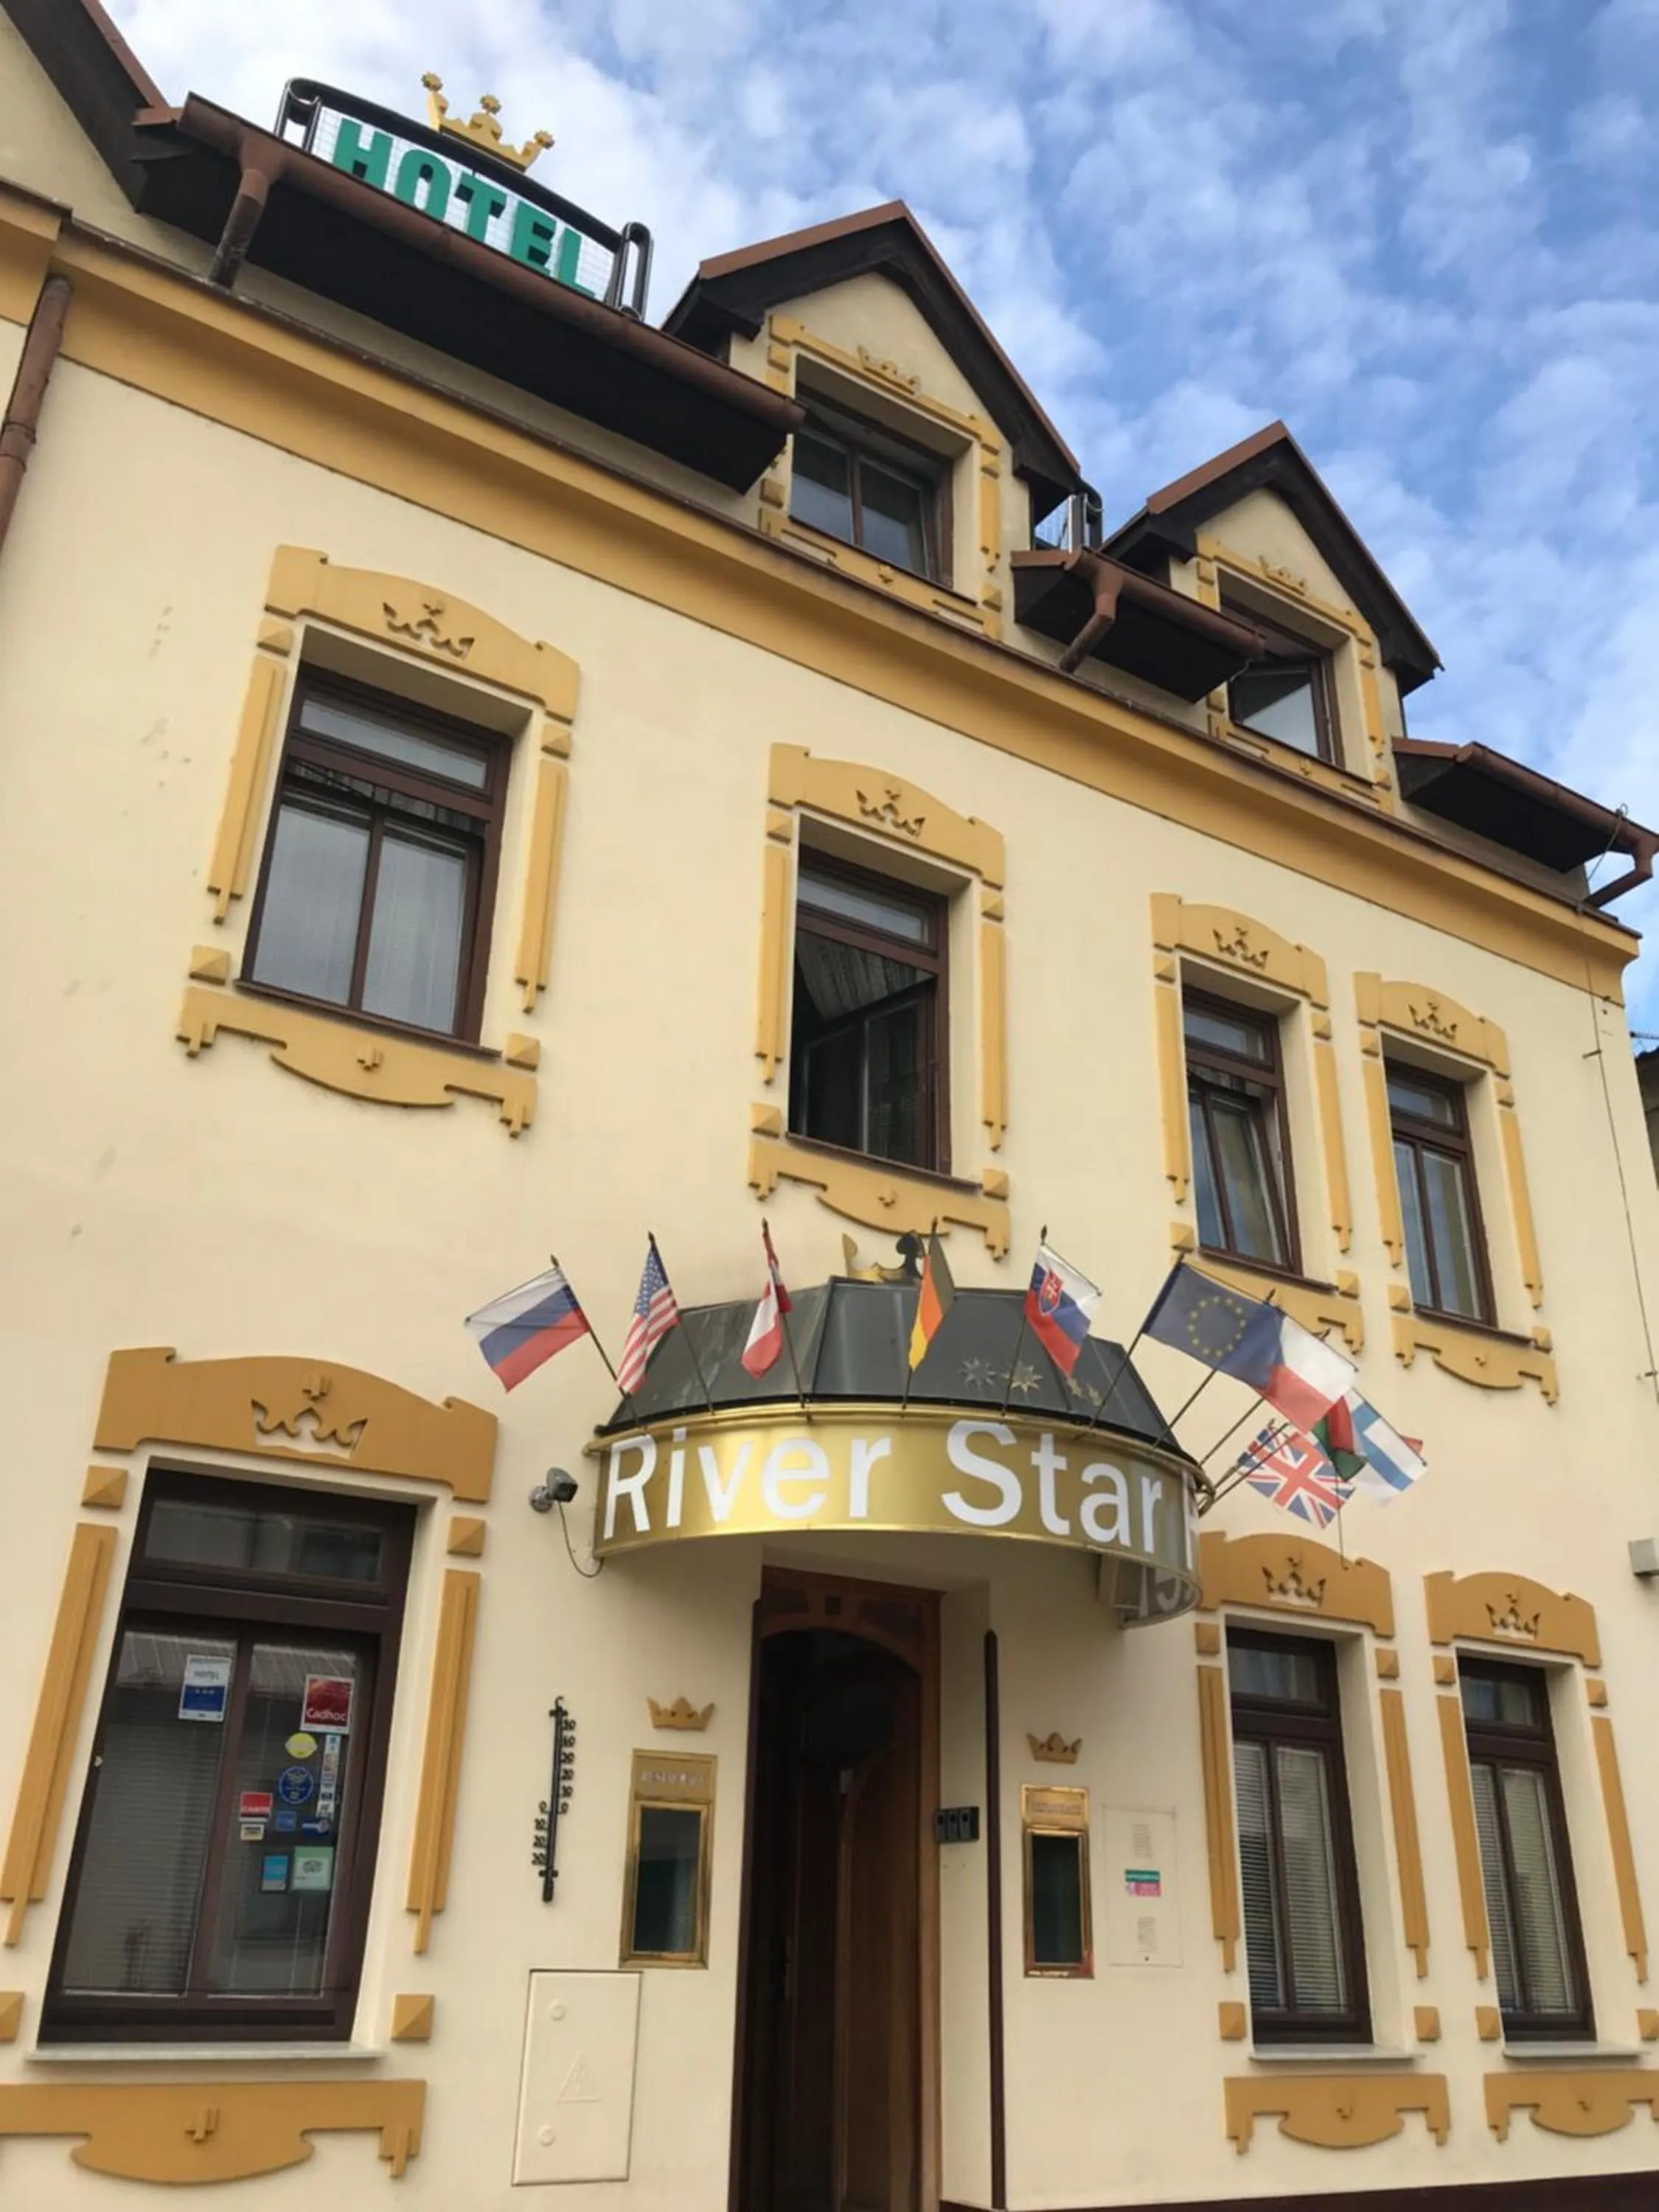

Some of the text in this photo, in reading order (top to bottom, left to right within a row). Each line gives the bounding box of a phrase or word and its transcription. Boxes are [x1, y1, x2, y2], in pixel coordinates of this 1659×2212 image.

[333, 117, 595, 299] HOTEL
[603, 1426, 891, 1540] River
[942, 1419, 1163, 1554] Star
